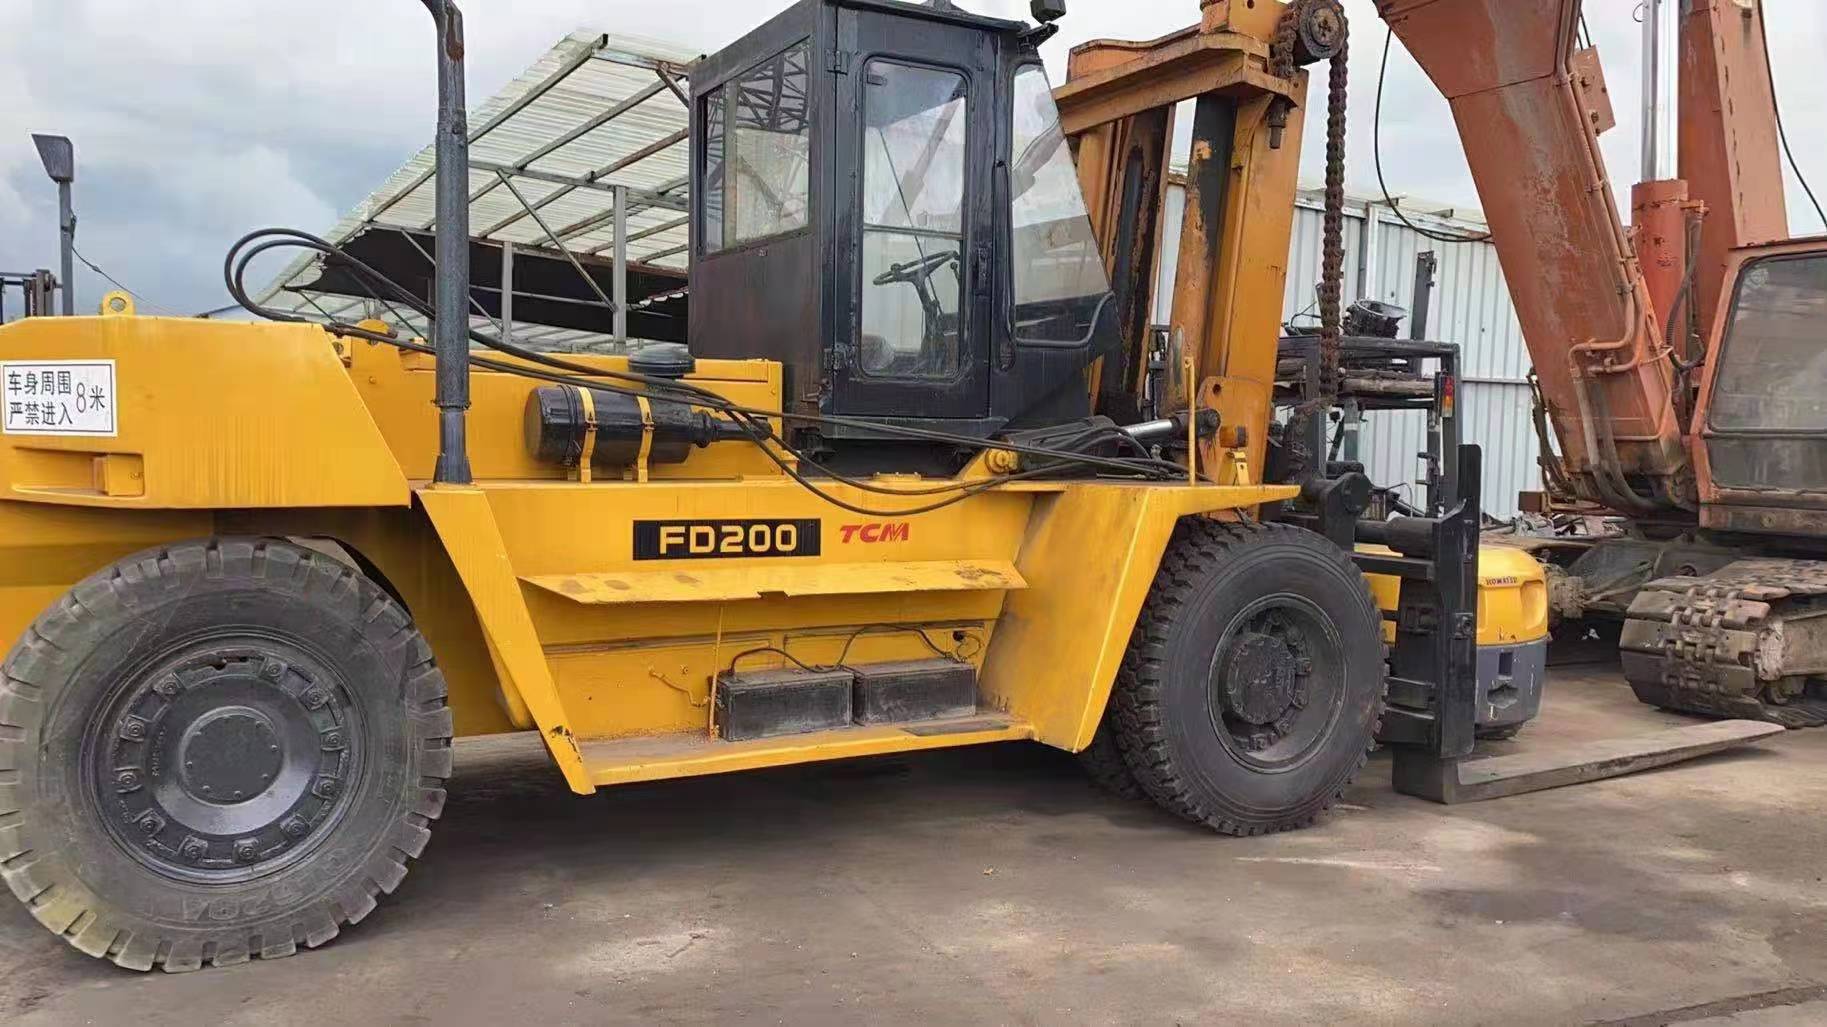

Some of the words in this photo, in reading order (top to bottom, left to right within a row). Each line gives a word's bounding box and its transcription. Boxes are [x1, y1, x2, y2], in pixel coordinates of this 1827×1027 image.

[8, 370, 72, 396] 车身周围
[9, 401, 73, 426] 严禁进入
[659, 523, 797, 554] FD200
[840, 522, 910, 544] TCM
